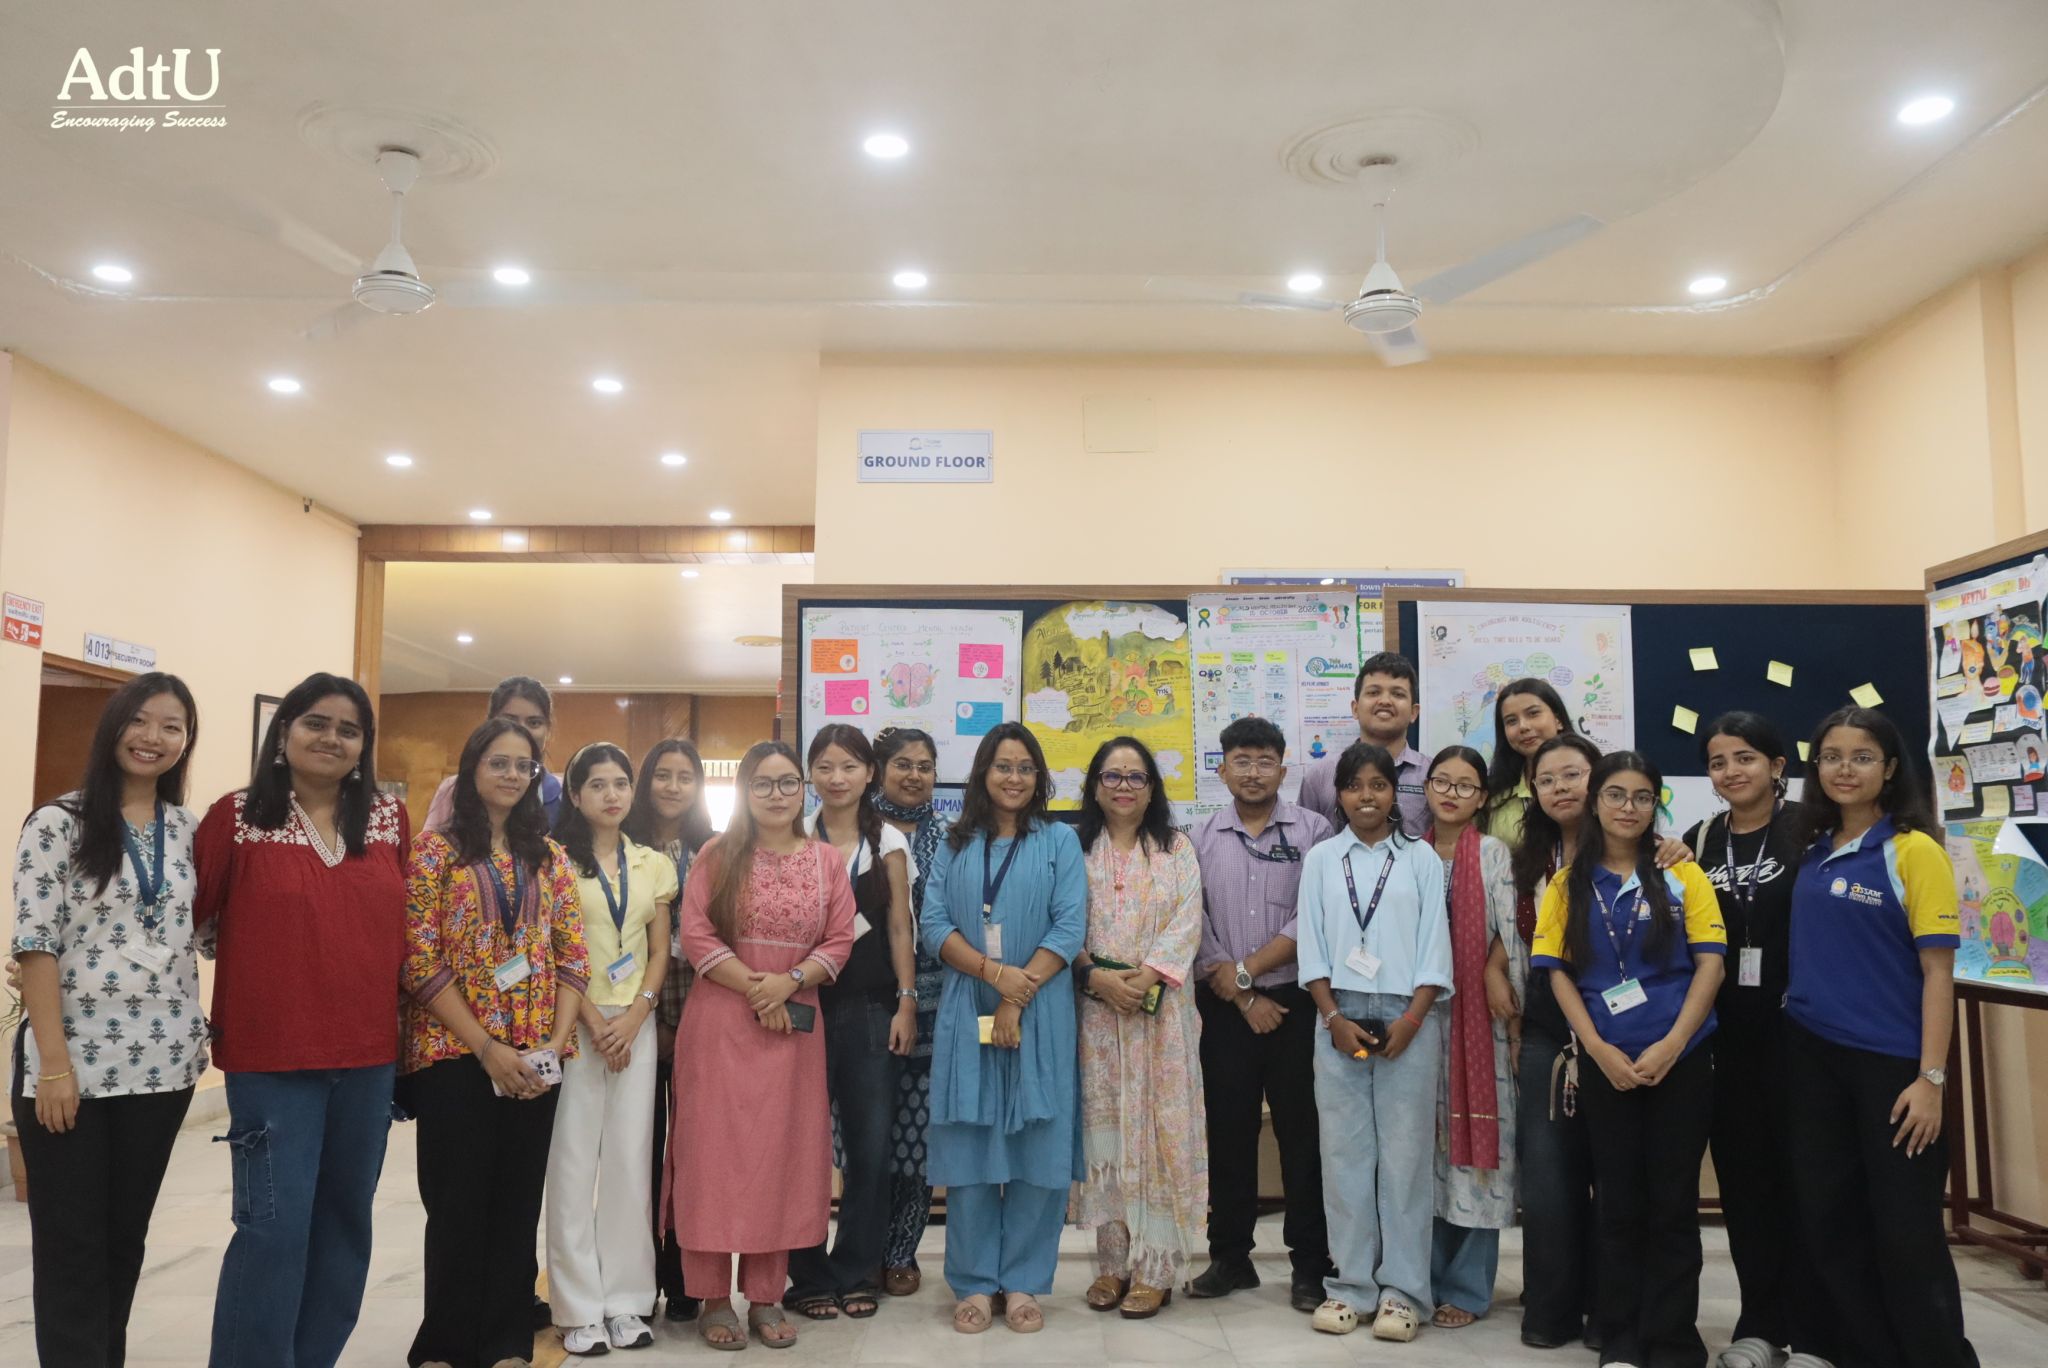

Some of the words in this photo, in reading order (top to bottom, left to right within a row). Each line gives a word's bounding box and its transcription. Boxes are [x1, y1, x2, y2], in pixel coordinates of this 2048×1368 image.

[864, 455, 931, 468] GROUND
[935, 456, 985, 468] FLOOR
[1359, 602, 1376, 610] FOR
[932, 799, 963, 812] HUMAN
